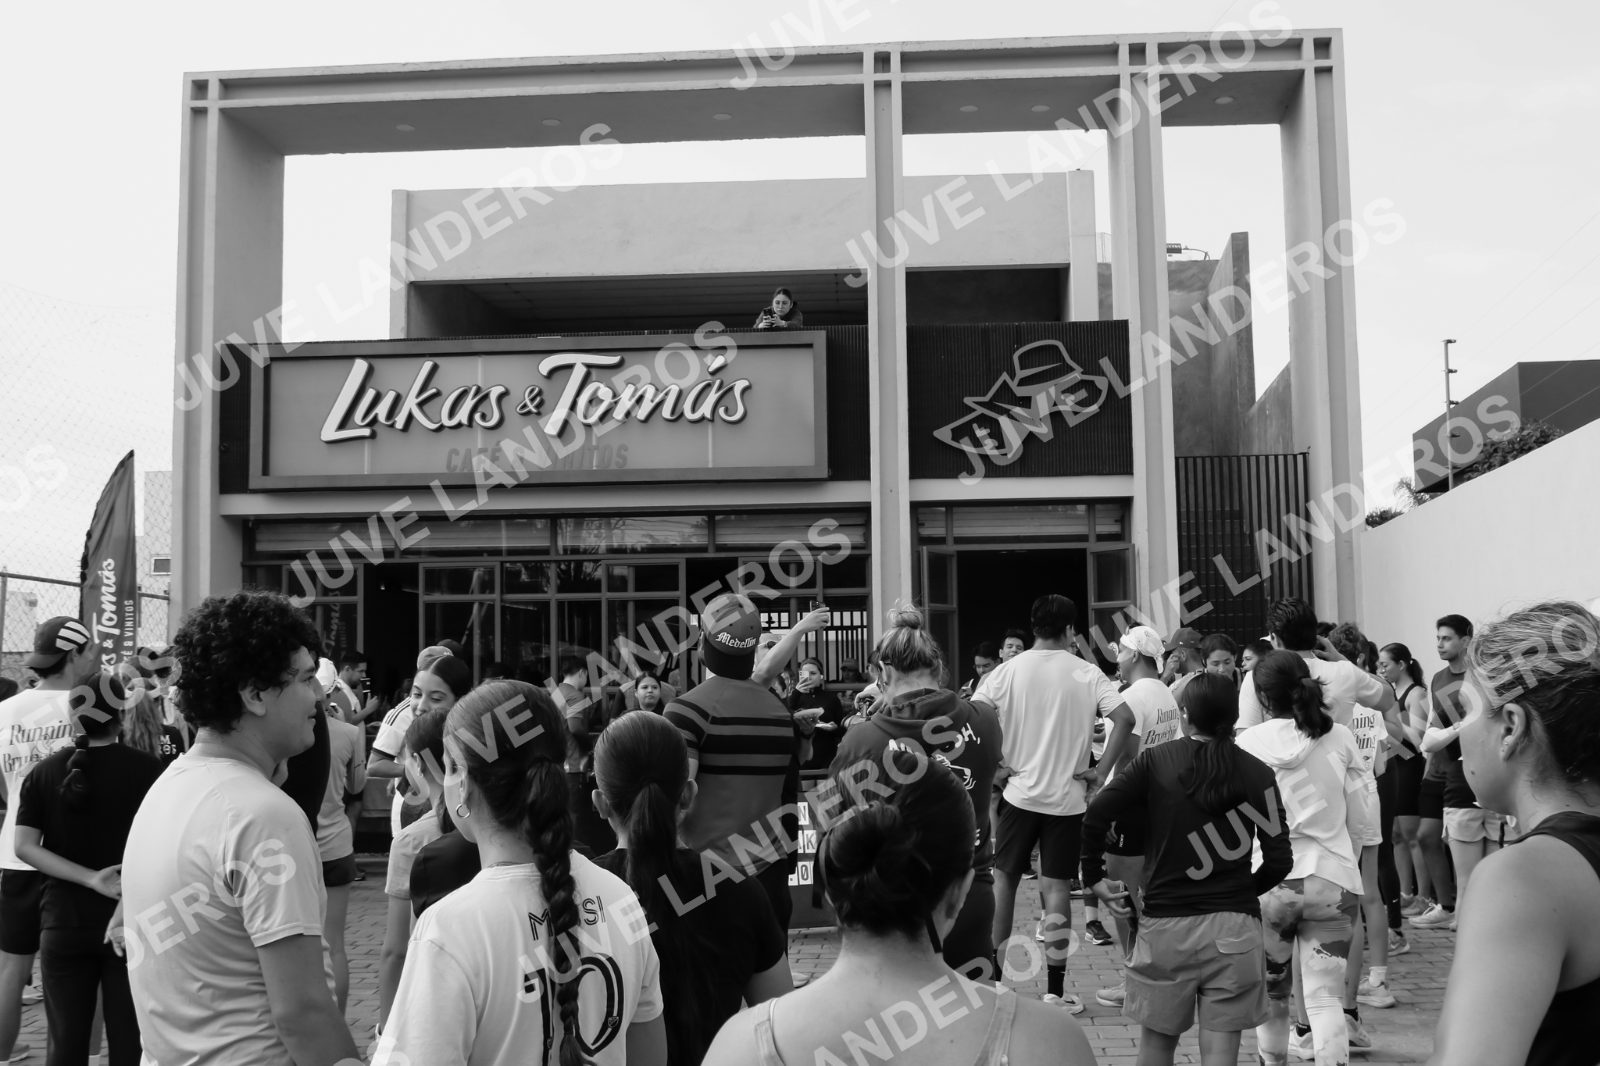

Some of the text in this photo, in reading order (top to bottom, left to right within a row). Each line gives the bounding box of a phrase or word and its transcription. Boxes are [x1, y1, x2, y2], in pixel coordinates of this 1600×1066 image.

[320, 353, 751, 442] Lukas & Tomás
[123, 600, 134, 637] VINITOS
[9, 720, 77, 746] Runnin
[528, 895, 606, 941] MSI
